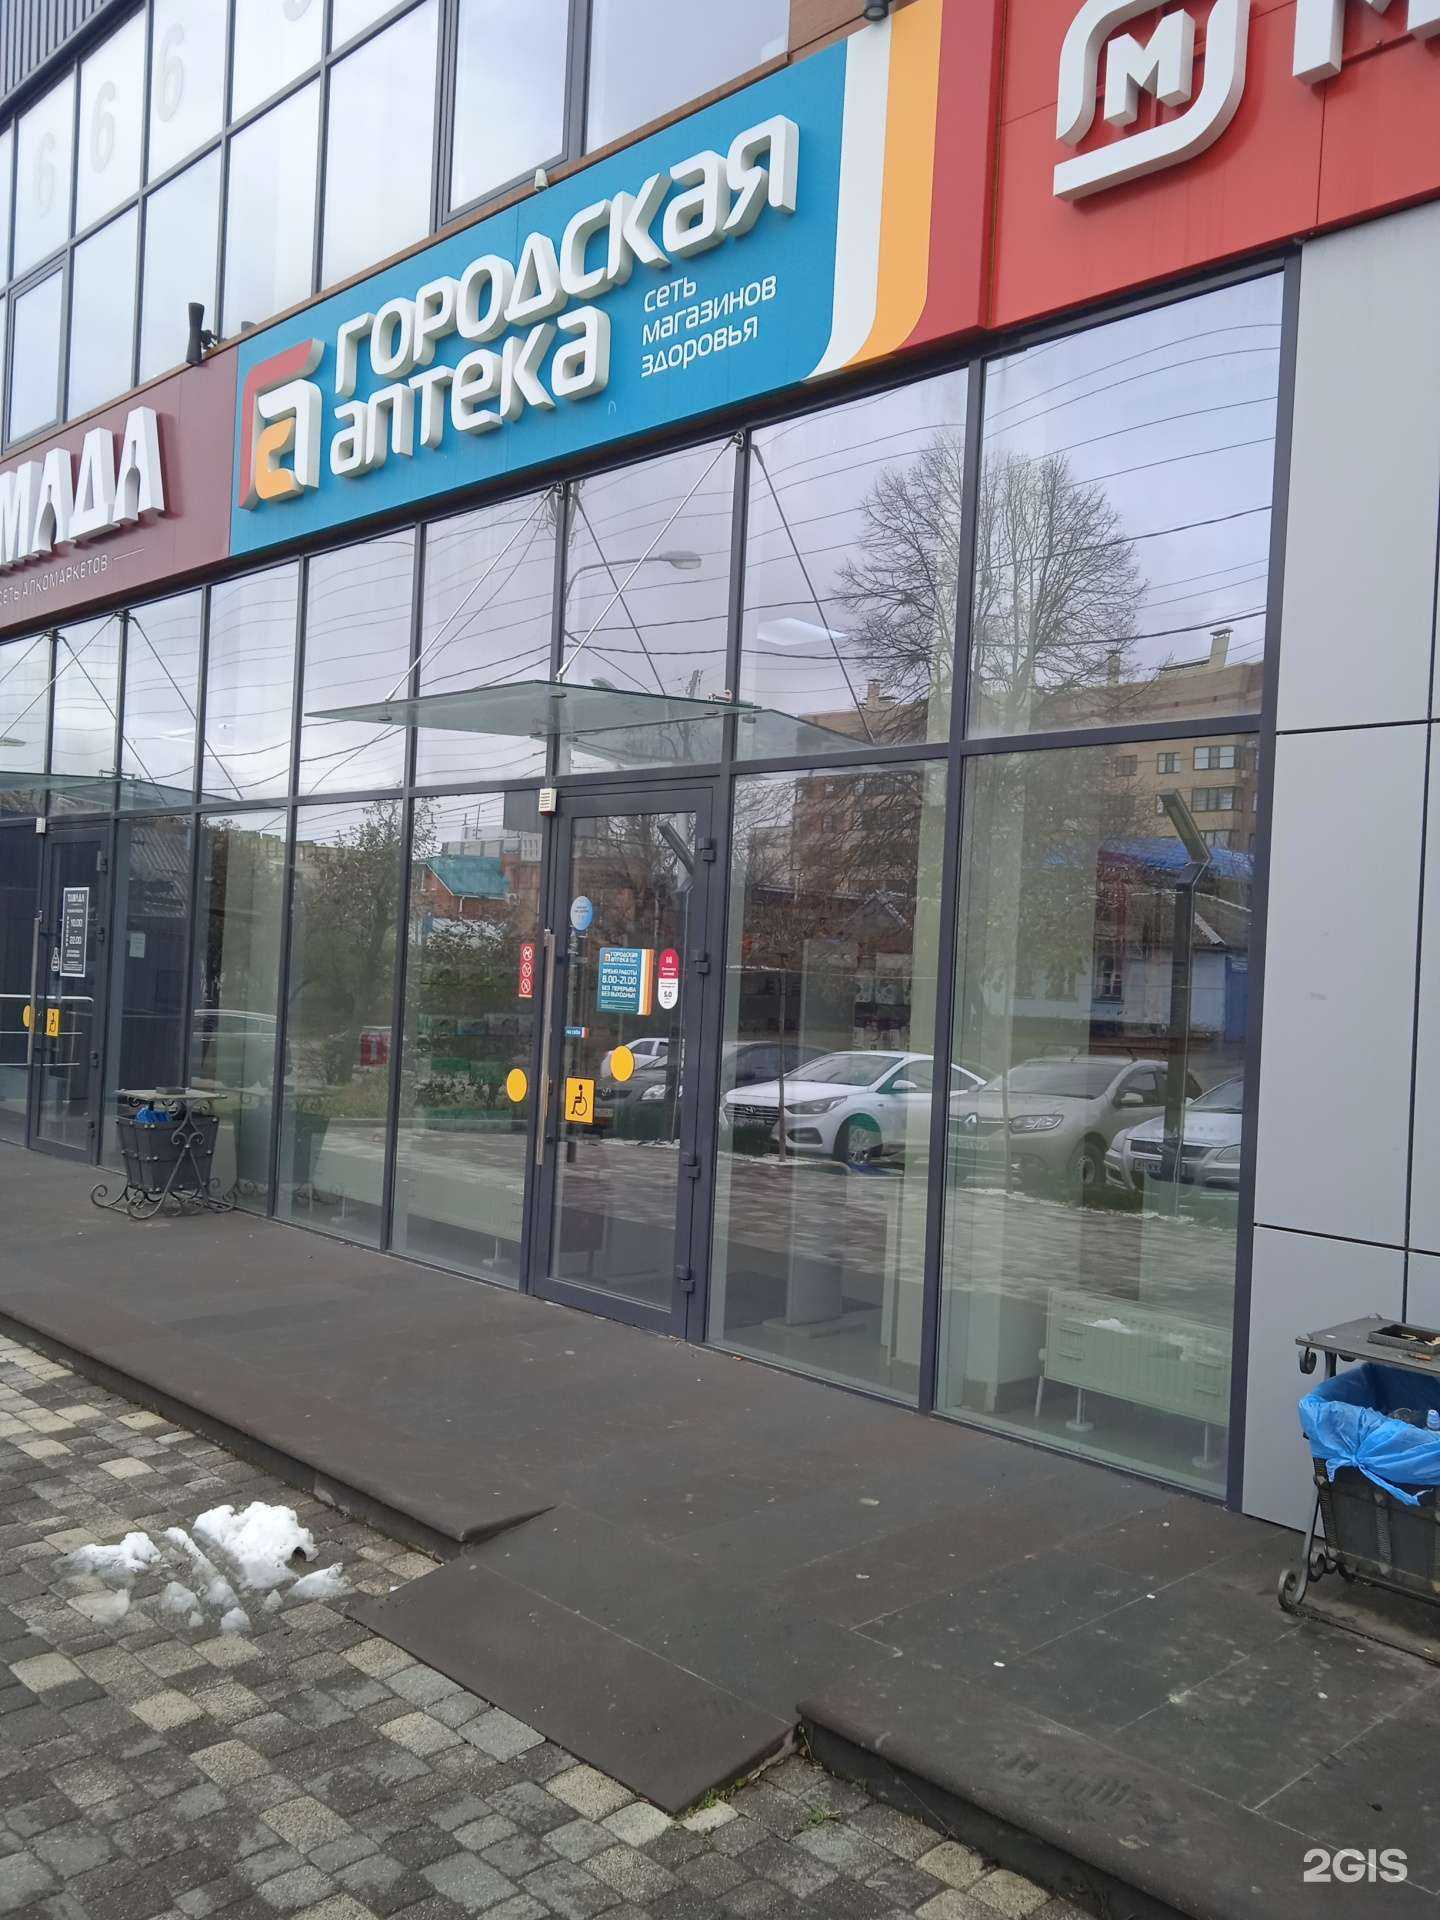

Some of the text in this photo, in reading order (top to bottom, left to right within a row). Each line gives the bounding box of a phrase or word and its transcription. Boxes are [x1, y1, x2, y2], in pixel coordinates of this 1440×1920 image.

[642, 275, 776, 346] магазинов
[644, 276, 697, 312] сеть
[641, 316, 758, 378] здоровья
